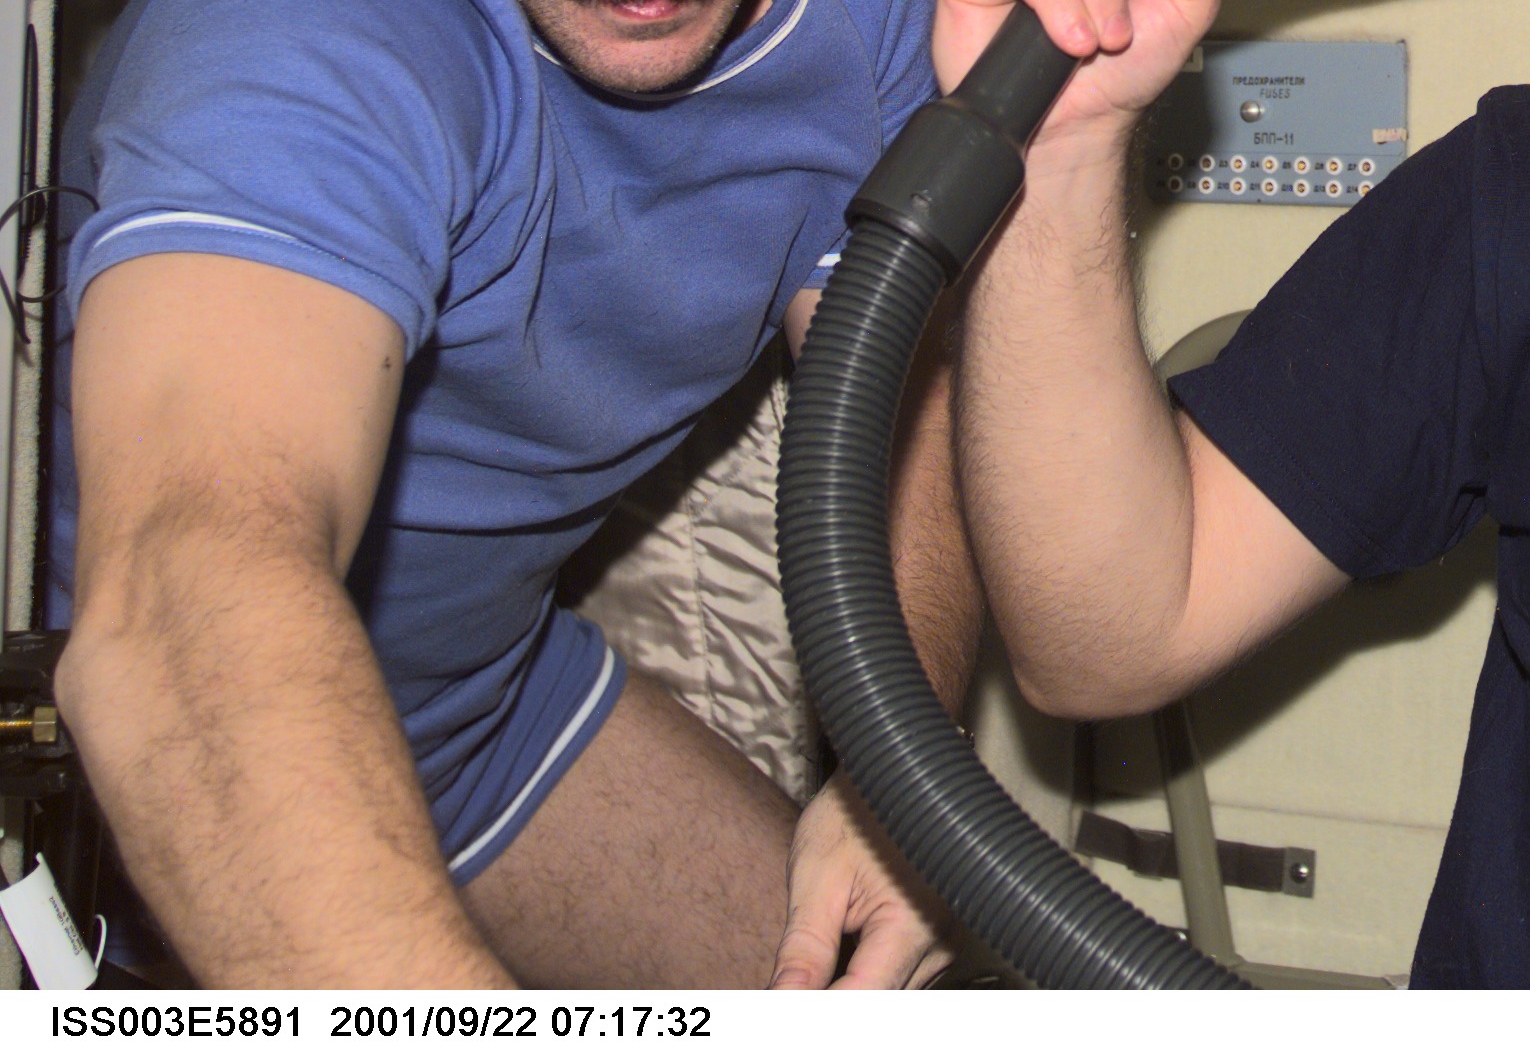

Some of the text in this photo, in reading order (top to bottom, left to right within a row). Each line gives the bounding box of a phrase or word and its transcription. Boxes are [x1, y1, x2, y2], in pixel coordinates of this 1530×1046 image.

[1232, 76, 1305, 86] ПРЕДОХРАНИТЕЛИ
[1259, 88, 1292, 99] FUSES
[1254, 132, 1294, 145] БПП-11
